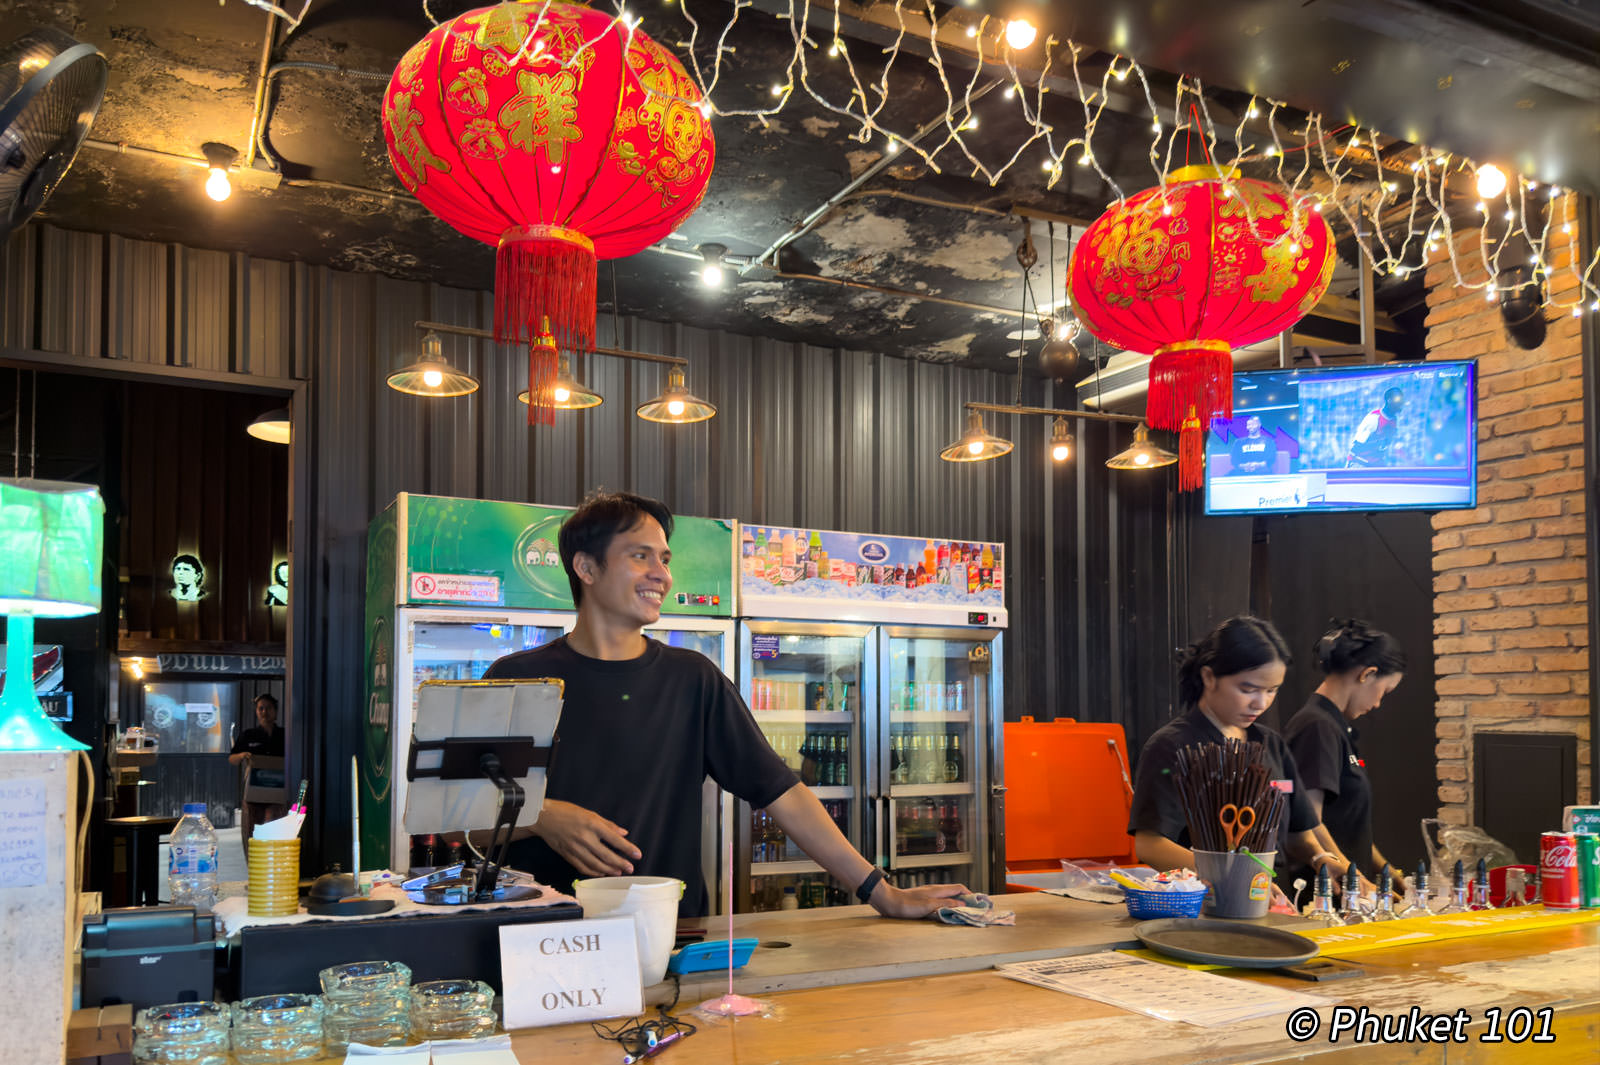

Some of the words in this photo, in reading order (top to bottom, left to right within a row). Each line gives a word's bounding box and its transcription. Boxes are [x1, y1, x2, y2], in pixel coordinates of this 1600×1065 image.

[1546, 845, 1578, 867] Cola
[539, 934, 601, 956] CASH
[541, 987, 607, 1011] ONLY
